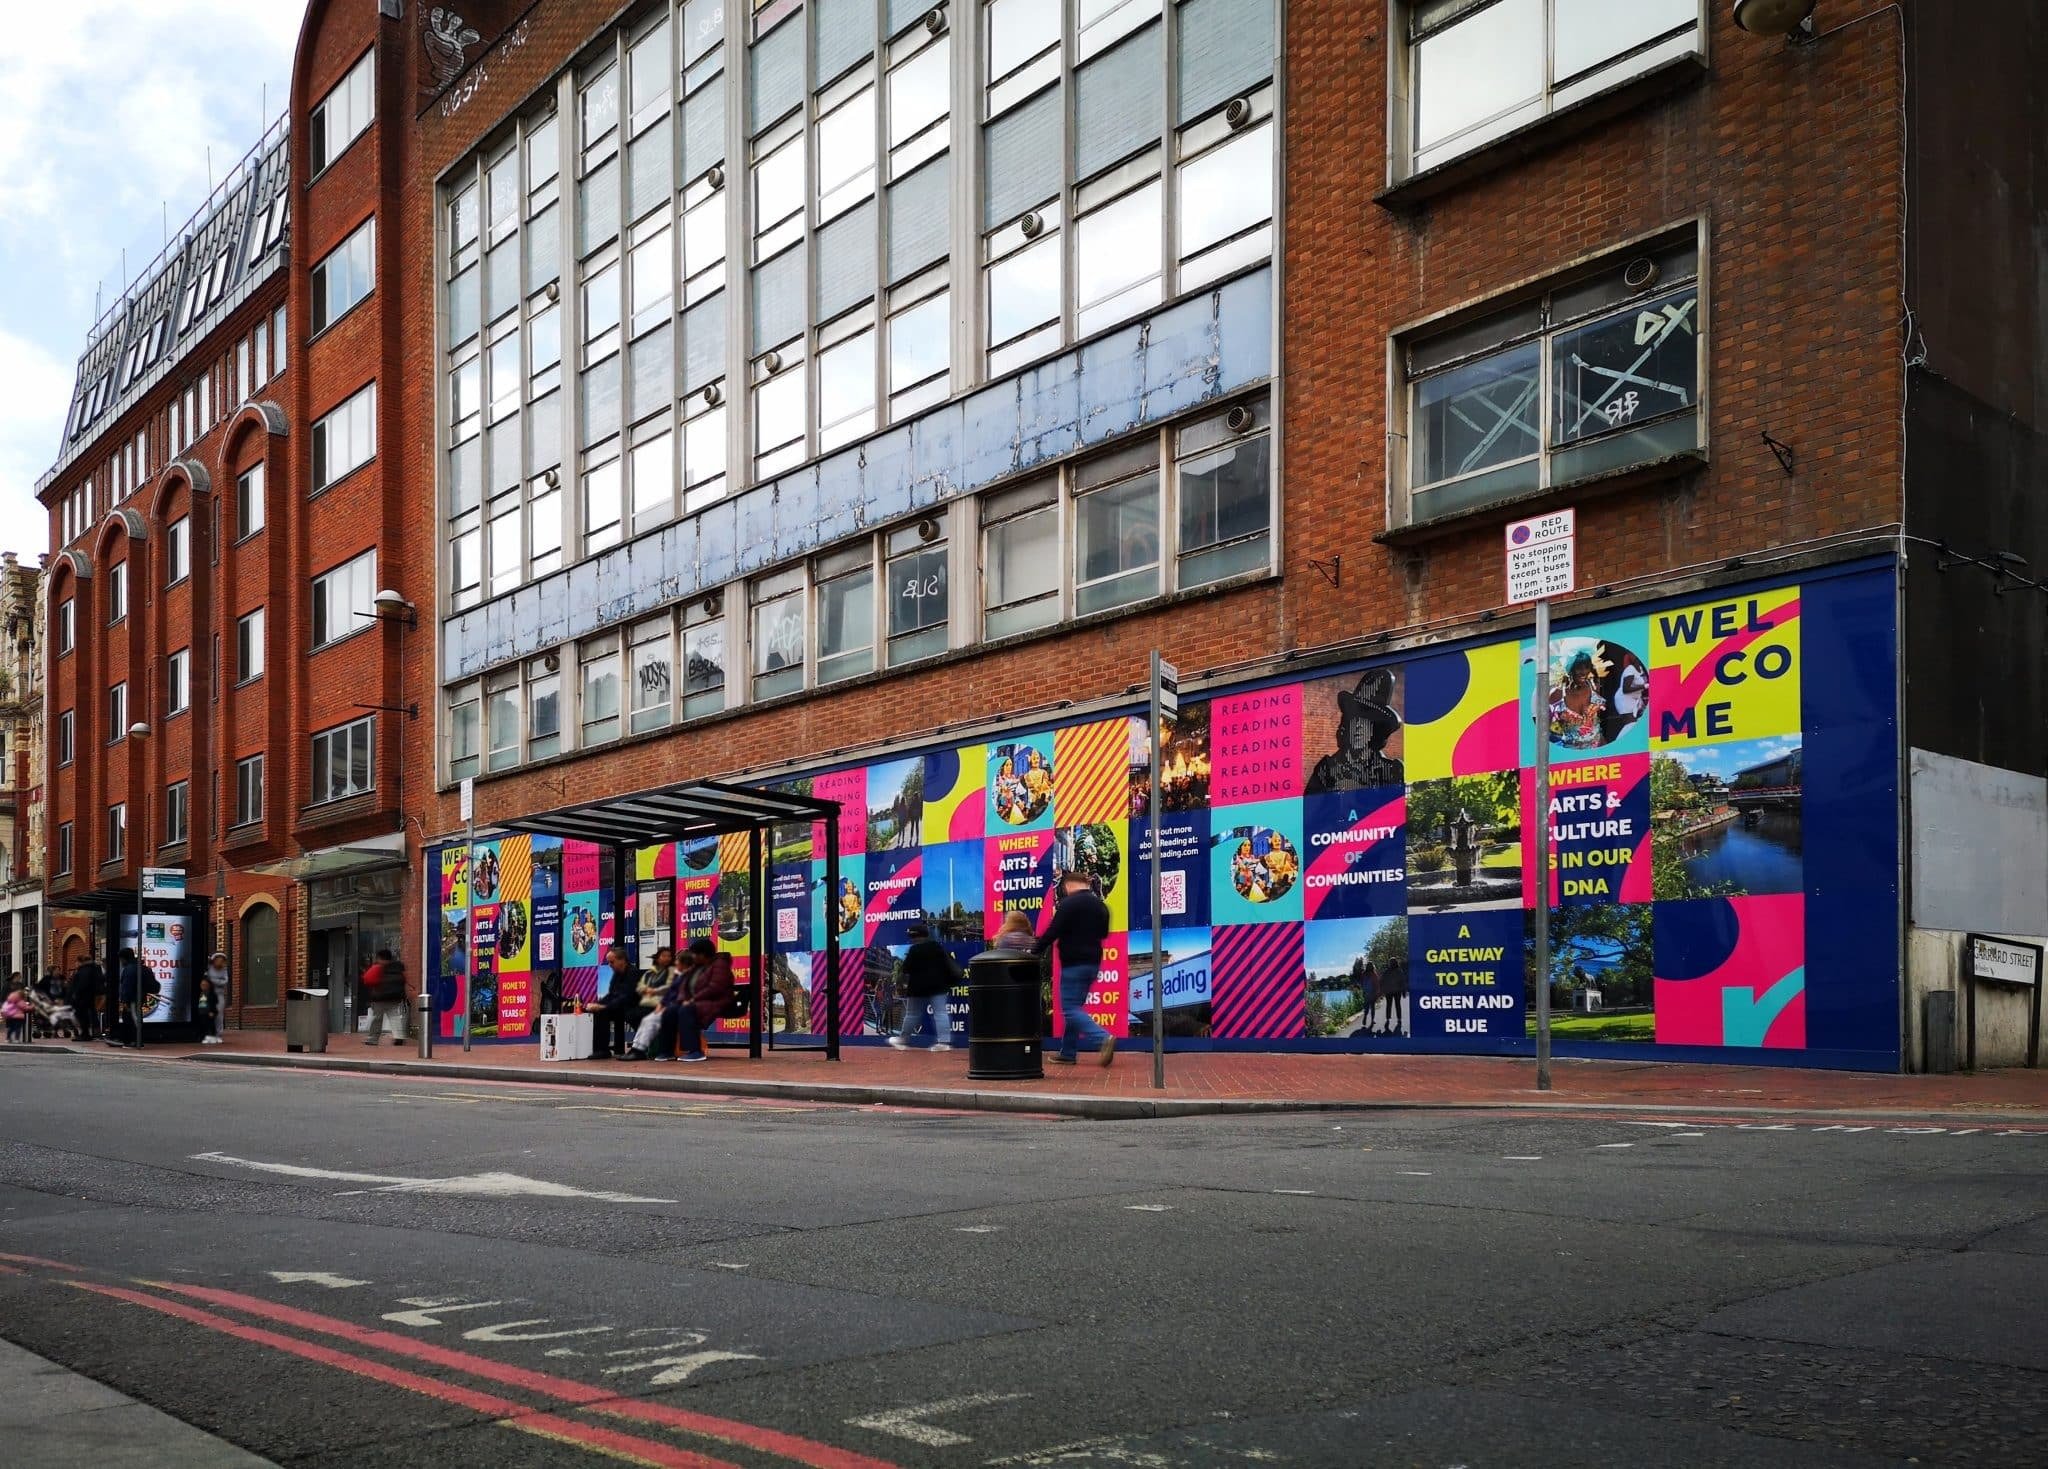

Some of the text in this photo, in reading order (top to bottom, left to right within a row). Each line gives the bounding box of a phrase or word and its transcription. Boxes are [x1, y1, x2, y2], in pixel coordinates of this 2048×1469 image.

[1542, 517, 1562, 528] RED
[1535, 525, 1569, 539] ROUTE
[1512, 543, 1568, 561] No stopping
[1511, 562, 1570, 580] except buses
[1513, 582, 1568, 600] except taxis
[1659, 599, 1775, 647] WEL
[1715, 645, 1792, 686] CO
[1221, 693, 1292, 716] READING
[1221, 714, 1291, 737] READING
[1660, 701, 1734, 742] ME
[1221, 736, 1291, 758] READING
[1221, 758, 1291, 778] READING
[1549, 763, 1622, 786] WHERE
[820, 776, 861, 789] READING
[1221, 779, 1292, 799] READING
[1549, 792, 1621, 815] ARTS &
[1348, 809, 1358, 822] A
[1161, 828, 1173, 836] out
[1311, 826, 1397, 847] COMMUNITY
[999, 836, 1039, 851] WHERE
[999, 856, 1038, 872] ARTS &
[1344, 851, 1363, 864] OF
[1549, 848, 1633, 870] S IN OUR
[890, 864, 896, 874] A
[685, 879, 710, 891] WHERE
[869, 877, 917, 891] COMMUNITY
[994, 876, 1044, 892] CULTURE
[1306, 869, 1404, 888] COMMUNITIES
[1564, 879, 1609, 896] DNA
[685, 896, 703, 906] ARTS
[887, 896, 898, 905] OF
[994, 897, 1043, 912] IS IN OUR
[866, 909, 921, 923] COMMUNITIES
[697, 927, 712, 937] OUR
[1458, 925, 1470, 938] A
[1425, 947, 1504, 964] GATEWAY
[2010, 952, 2034, 968] STREET
[503, 982, 518, 990] HOME
[1436, 972, 1495, 986] TO THE
[503, 996, 517, 1004] OVER
[1103, 992, 1120, 1004] OF
[1419, 995, 1514, 1010] GREEN AND
[502, 1009, 518, 1018] YEARS
[503, 1023, 525, 1031] HISTORY
[1445, 1019, 1487, 1033] BLUE
